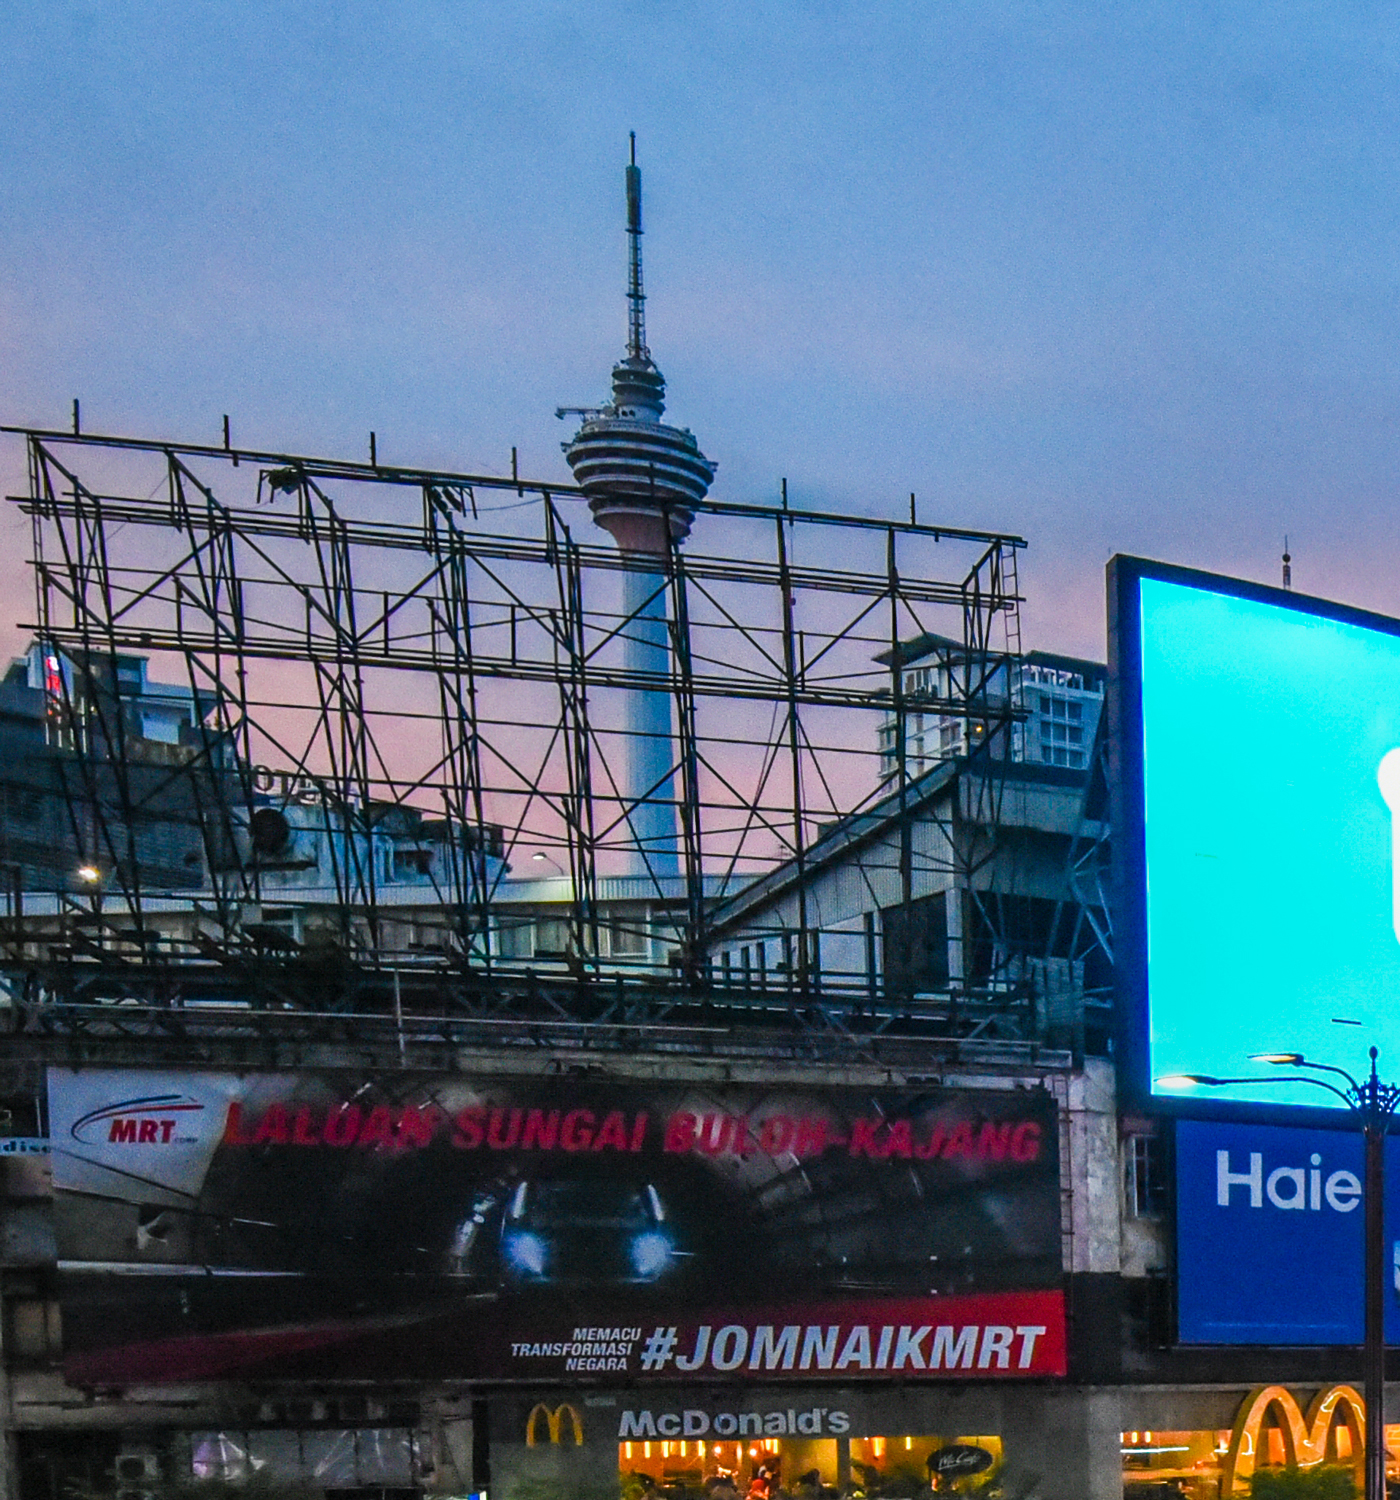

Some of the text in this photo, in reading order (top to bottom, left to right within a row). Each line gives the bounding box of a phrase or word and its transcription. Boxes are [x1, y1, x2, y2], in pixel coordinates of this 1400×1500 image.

[108, 1119, 176, 1144] MRT
[224, 1102, 437, 1149] LALUAN
[455, 1107, 648, 1153] SUNGAI
[1216, 1150, 1364, 1214] Haie
[572, 1327, 642, 1342] MEMACU
[640, 1325, 1047, 1371] #JOMNAIKMRT
[511, 1343, 633, 1357] TRANSFORMASI
[565, 1357, 628, 1371] NEGARA
[618, 1408, 851, 1439] McDonald's
